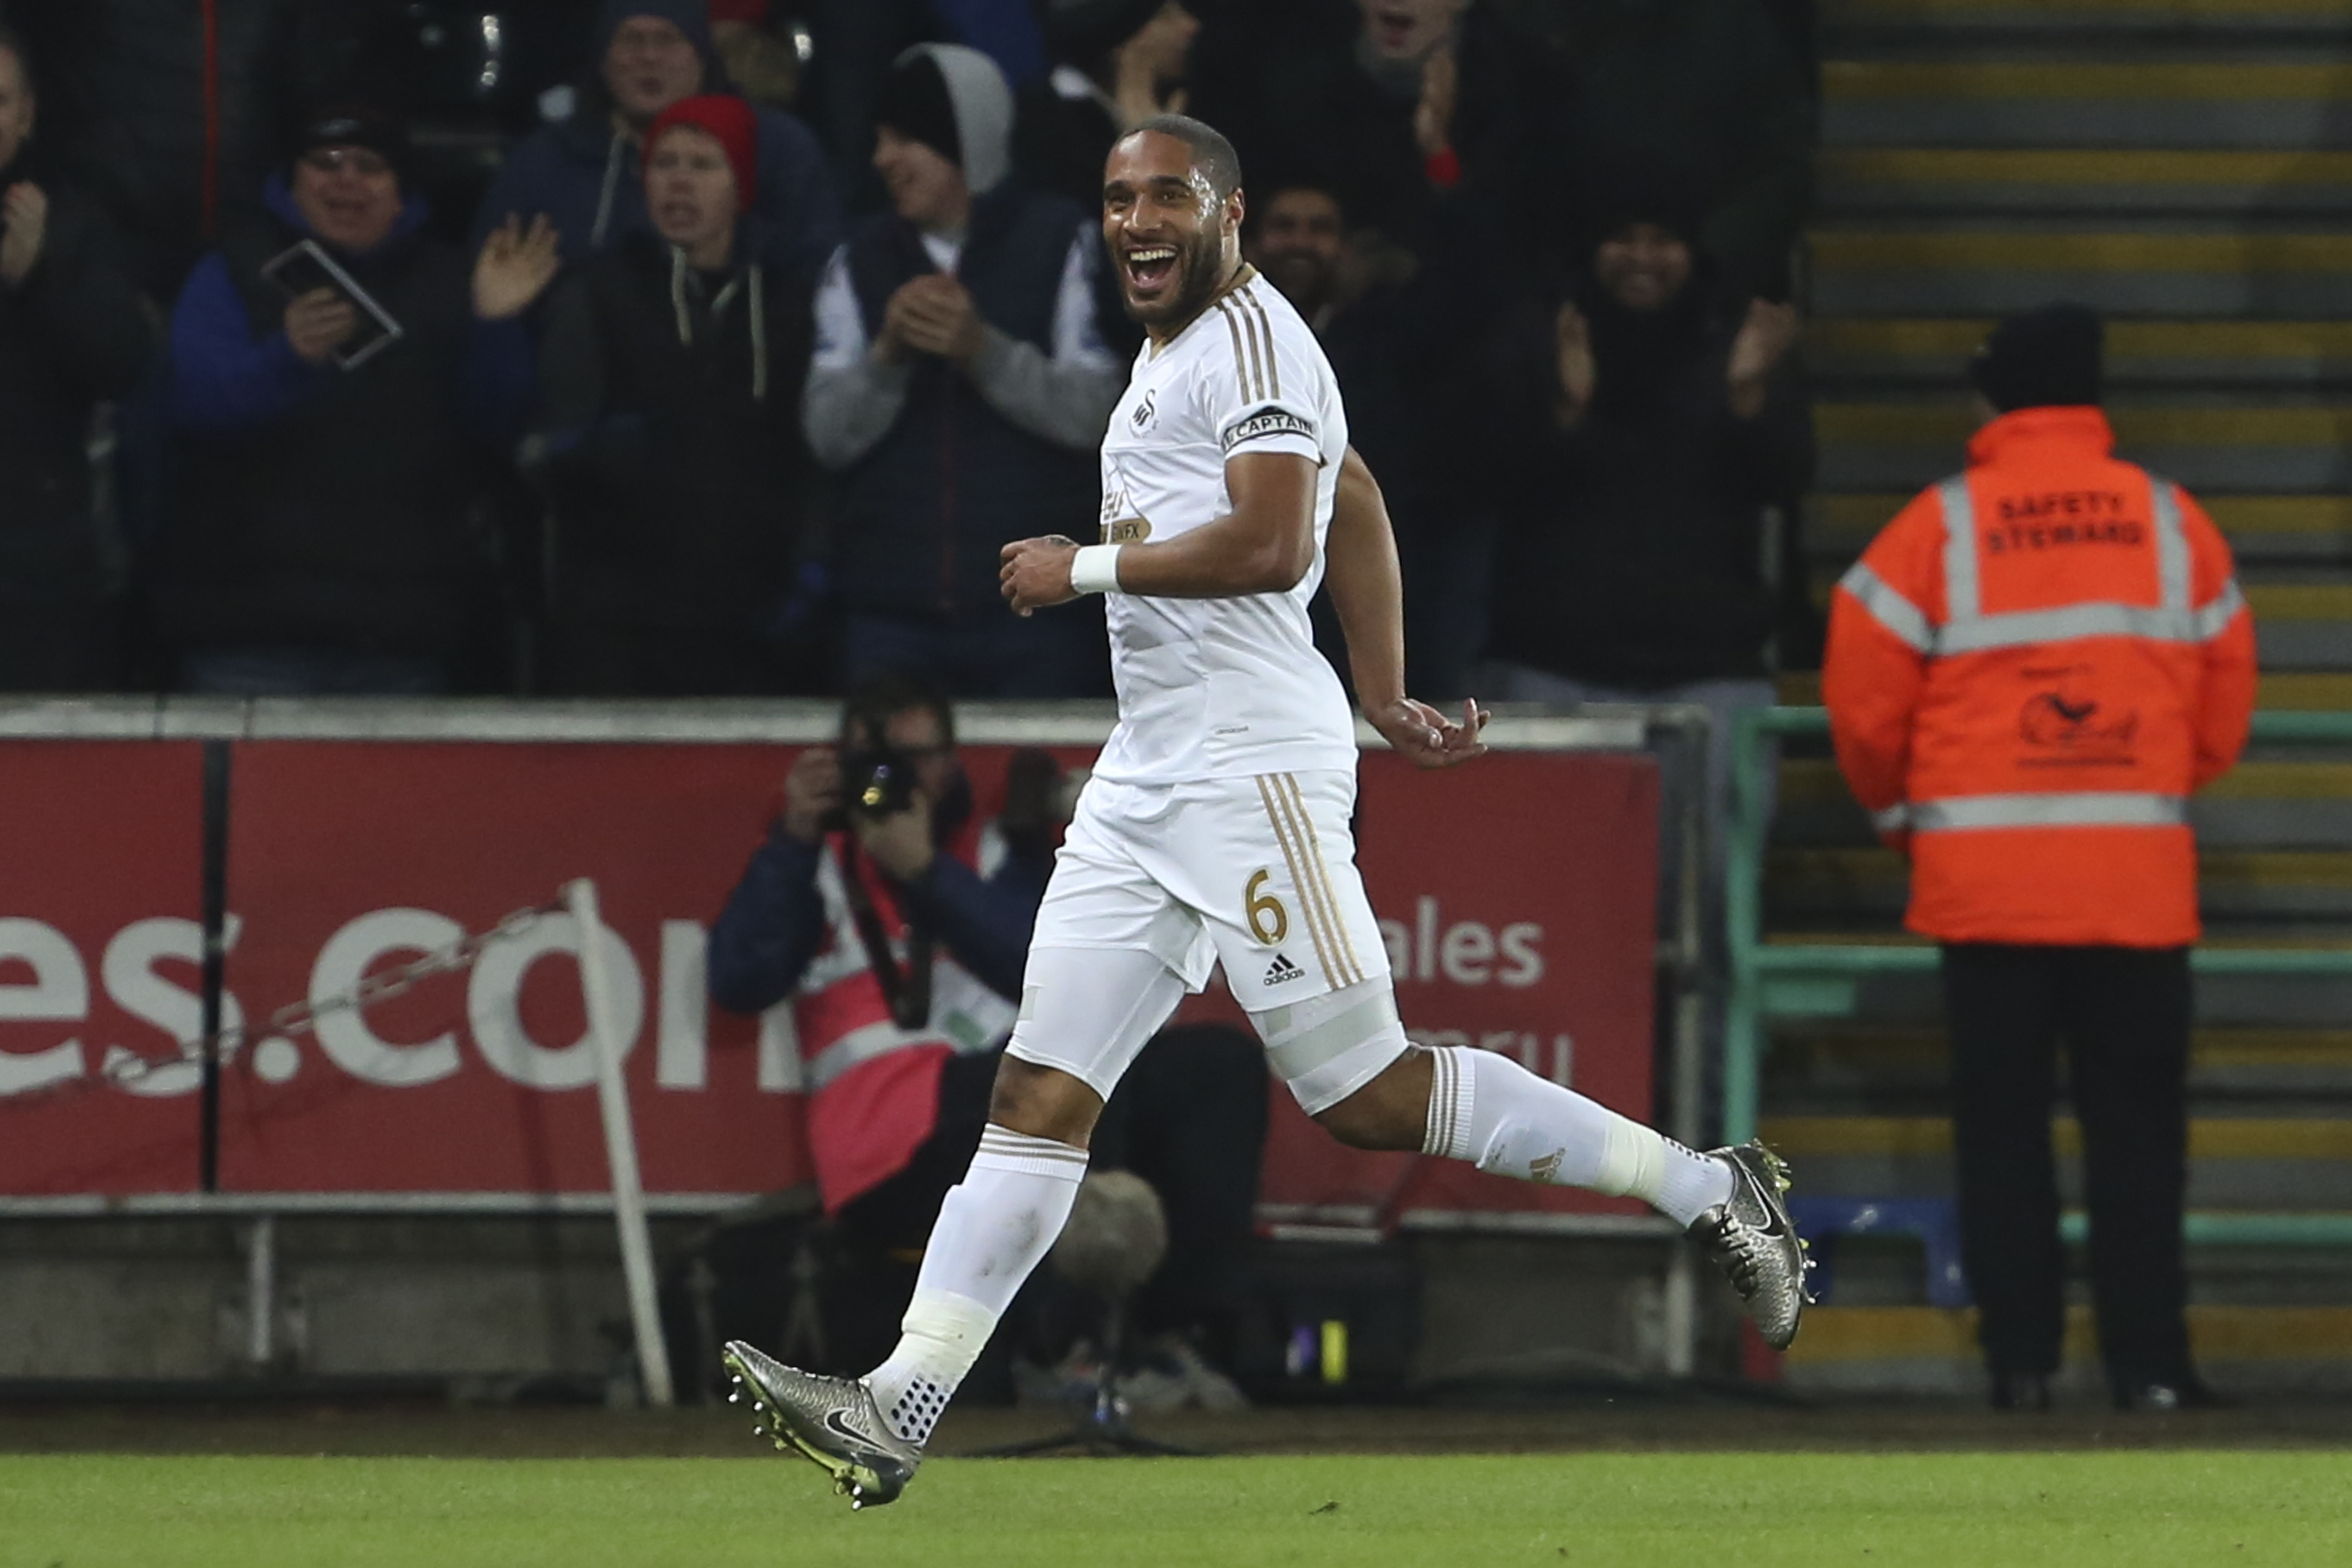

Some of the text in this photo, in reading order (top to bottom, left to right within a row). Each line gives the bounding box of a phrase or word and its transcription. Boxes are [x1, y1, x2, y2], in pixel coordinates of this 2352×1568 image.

[1236, 414, 1314, 437] CAPTAIN
[1998, 491, 2123, 521] SAFETY
[1988, 519, 2143, 553] STEWARD
[1245, 868, 1288, 946] 6
[1263, 968, 1305, 986] adidas
